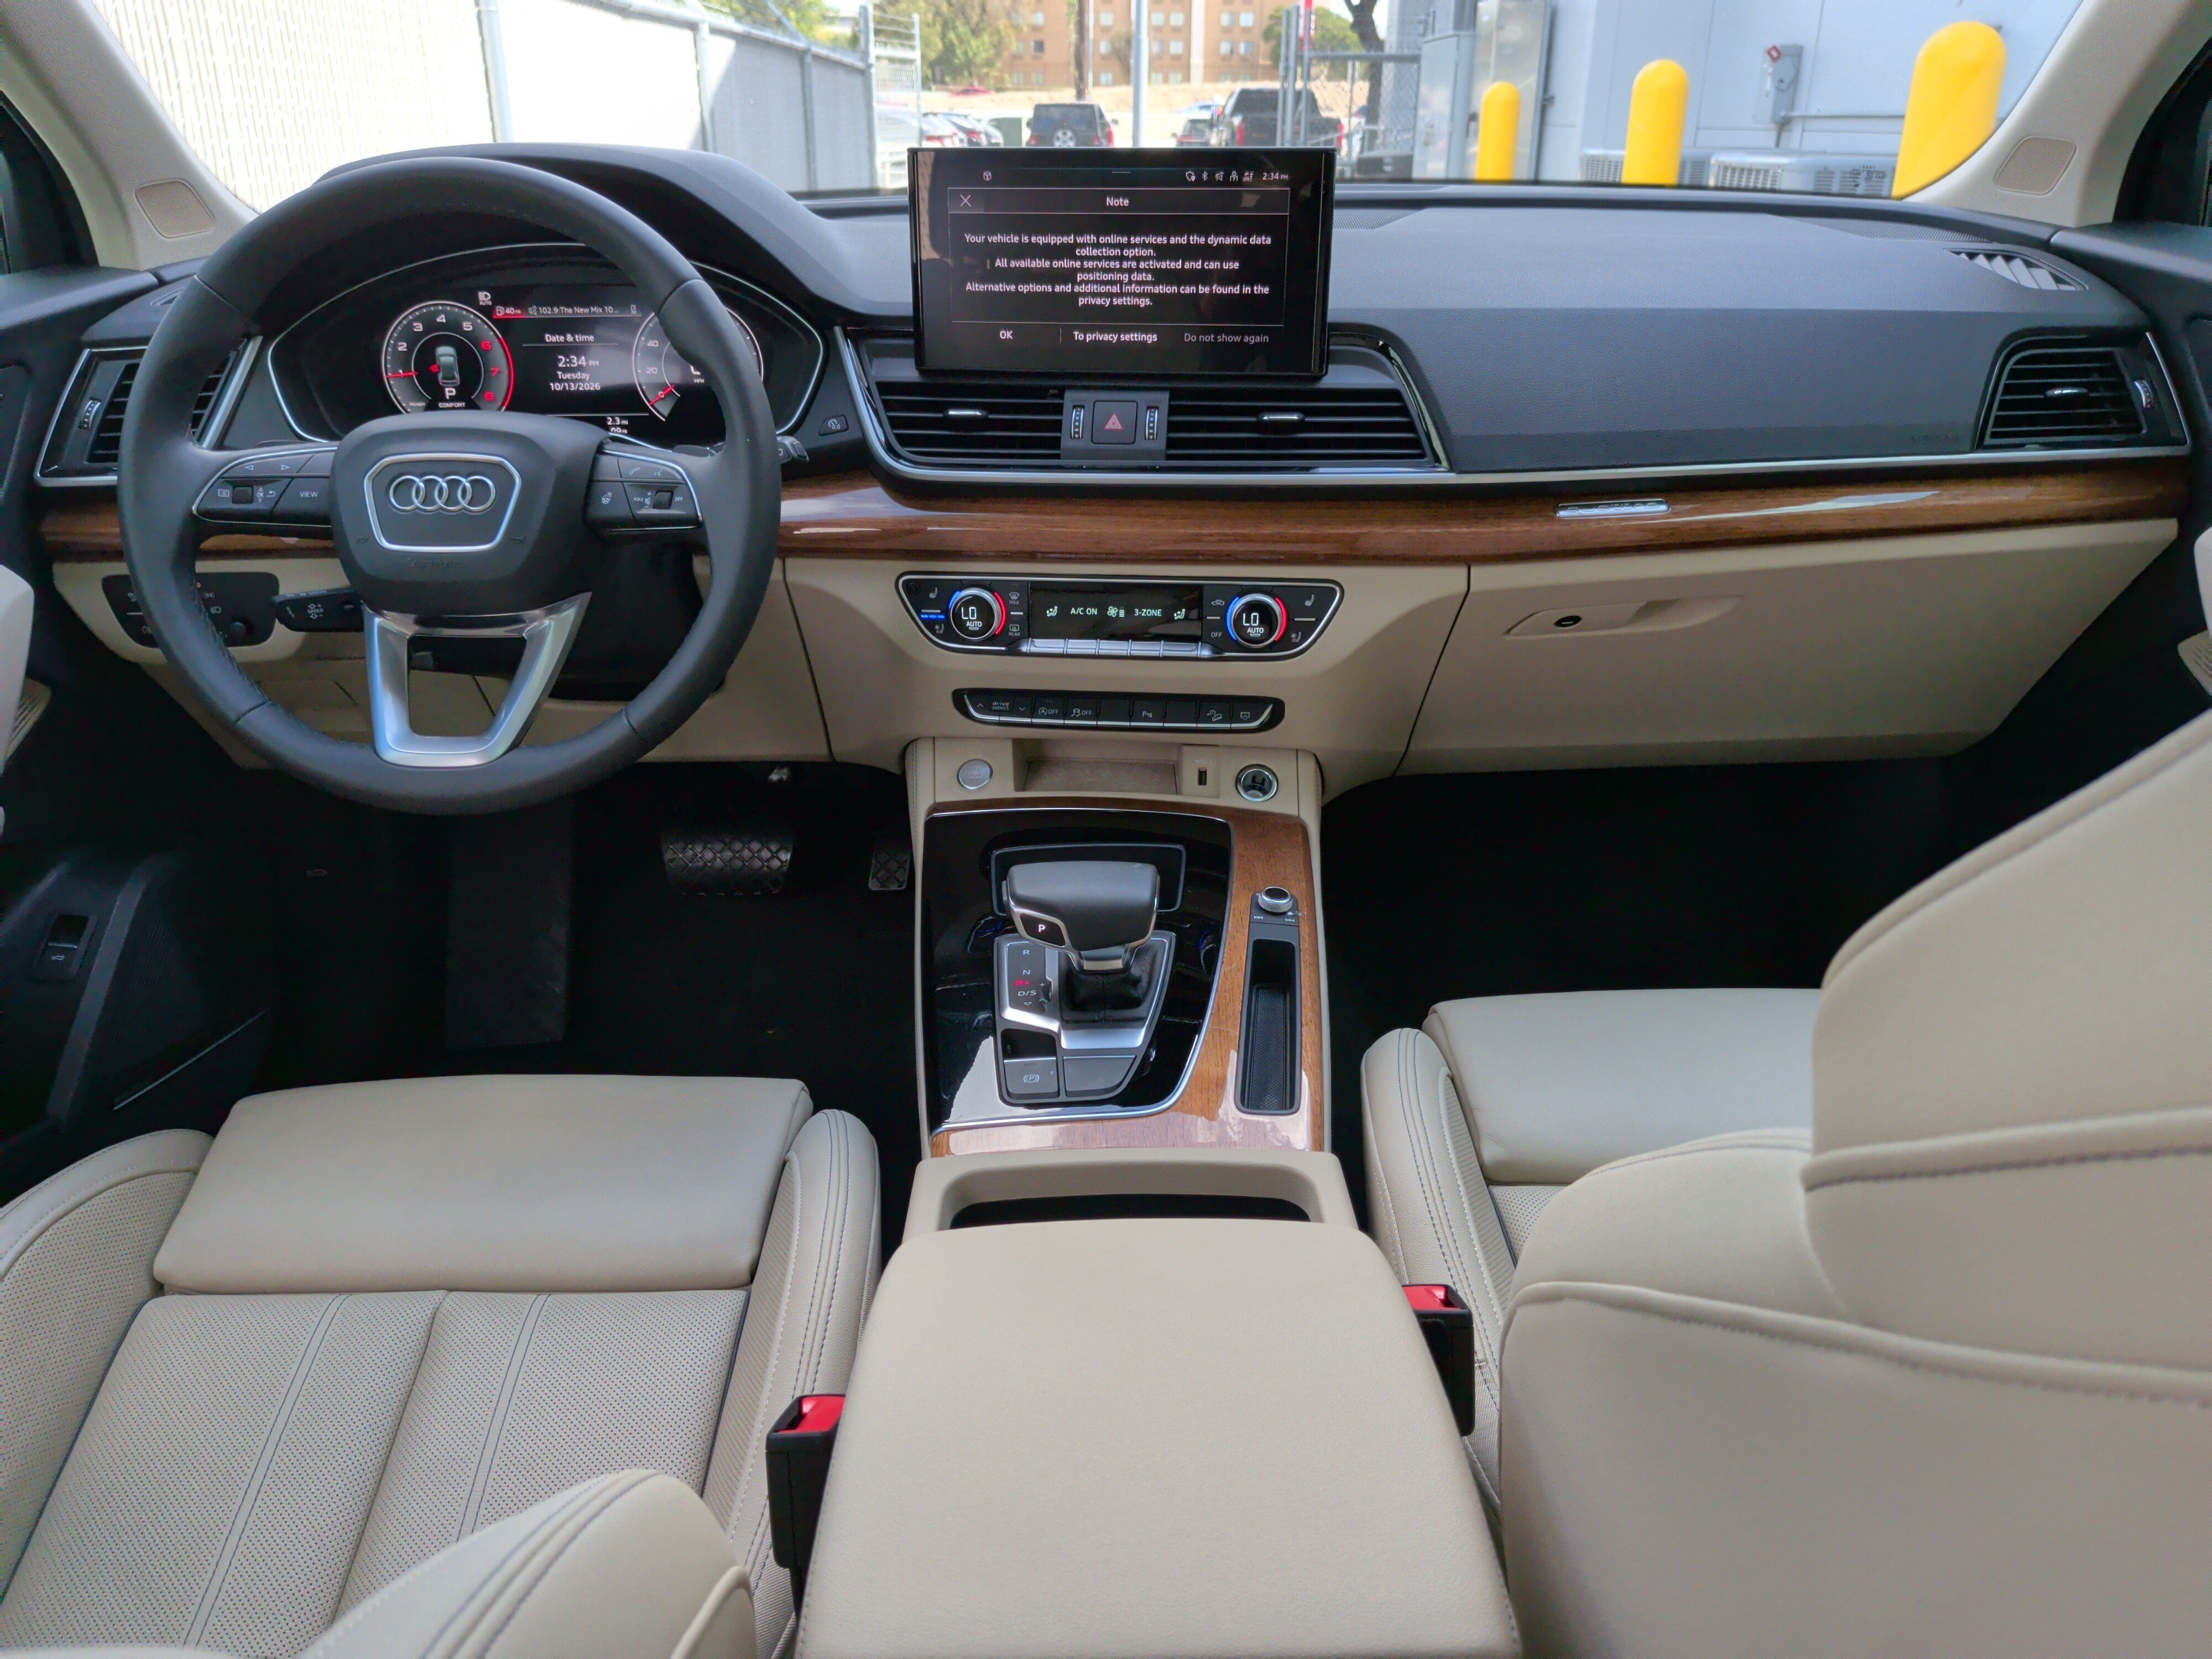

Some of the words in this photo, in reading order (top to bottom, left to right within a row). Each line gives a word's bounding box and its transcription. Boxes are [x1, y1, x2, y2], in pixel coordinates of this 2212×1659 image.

[1262, 172, 1279, 180] 2:34
[1106, 196, 1129, 206] Note
[964, 233, 985, 243] Your
[987, 233, 1019, 243] vehicle
[1021, 234, 1029, 243] is
[1031, 234, 1074, 246] equipped
[1076, 234, 1097, 244] with
[1099, 234, 1128, 244] online
[1130, 234, 1167, 244] services
[1170, 234, 1187, 244] and
[1189, 234, 1206, 244] the
[1207, 234, 1248, 247] dynamic
[1249, 235, 1271, 244] data
[1076, 246, 1121, 256] collection
[1123, 247, 1156, 258] option.
[995, 258, 1008, 268] All
[1009, 258, 1050, 268] available
[1052, 258, 1081, 268] online
[1083, 259, 1120, 268] services
[1122, 260, 1137, 269] are
[1139, 259, 1182, 269] activated
[1184, 259, 1202, 269] and
[1077, 272, 1129, 283] positioning
[1131, 272, 1155, 281] data.
[966, 281, 1016, 291] Alternative
[1018, 283, 1052, 294] options
[1054, 283, 1072, 293] and
[1073, 282, 1120, 293] additional
[1123, 283, 1177, 293] information
[1198, 284, 1210, 294] be
[1212, 284, 1240, 294] found
[1243, 285, 1251, 294] in
[1253, 285, 1269, 294] the
[1078, 296, 1111, 307] privacy
[1113, 296, 1152, 307] settings.
[436, 314, 446, 323] 4
[413, 322, 423, 332] 3
[463, 322, 473, 331] 5
[545, 334, 565, 342] Date
[566, 333, 573, 342] &
[999, 330, 1013, 340] OK
[1073, 331, 1084, 341] To
[1086, 332, 1118, 343] privacy
[1120, 332, 1157, 343] settings
[1184, 333, 1197, 342] Do
[1199, 333, 1215, 342] not
[1217, 333, 1241, 342] show
[1243, 334, 1269, 345] again
[398, 342, 408, 351] 2
[482, 341, 492, 349] 6
[558, 356, 587, 367] 2:34
[491, 368, 500, 377] 7
[557, 371, 590, 381] Tuesday
[550, 382, 601, 390] 10/13/2026
[445, 387, 456, 399] P
[485, 392, 494, 400] 8
[607, 417, 620, 425] 2.3
[961, 607, 977, 620] LO
[1070, 607, 1084, 615] A/C
[1243, 613, 1259, 626] LO
[1038, 924, 1046, 933] P
